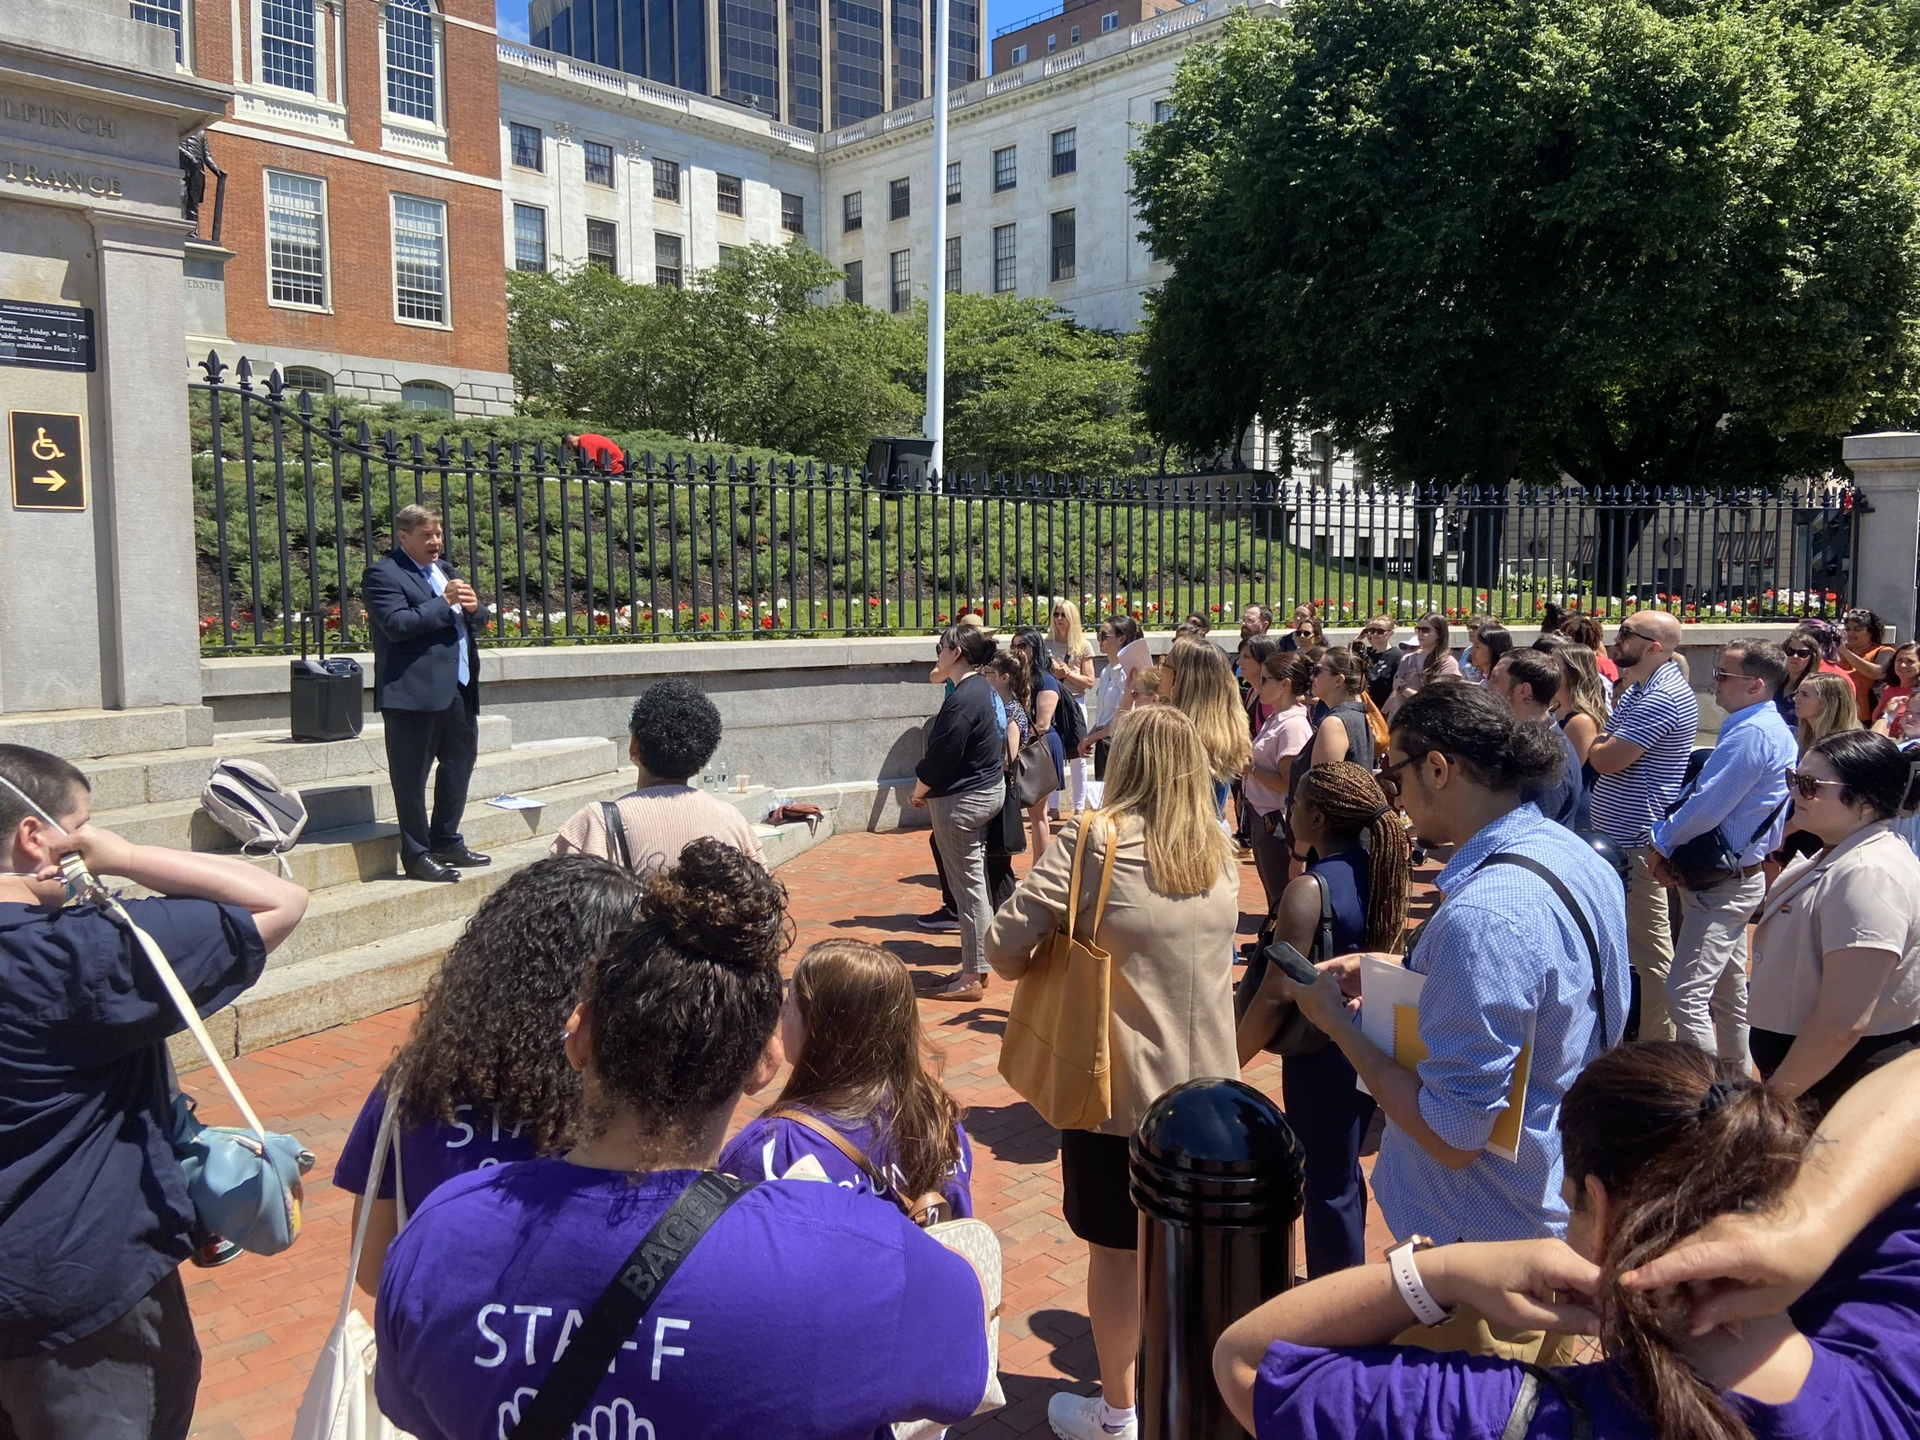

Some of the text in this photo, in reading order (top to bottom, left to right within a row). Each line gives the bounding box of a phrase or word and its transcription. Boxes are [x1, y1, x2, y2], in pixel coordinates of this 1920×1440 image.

[4, 100, 117, 139] LFINCH
[2, 161, 123, 197] TRANCE
[2, 304, 44, 313] MASSACHUSETTS
[30, 327, 51, 337] Friday,
[18, 334, 47, 343] welcome.
[16, 342, 43, 350] available
[53, 344, 70, 353] Floor
[71, 346, 78, 354] 2.
[619, 1177, 728, 1301] BAGGU
